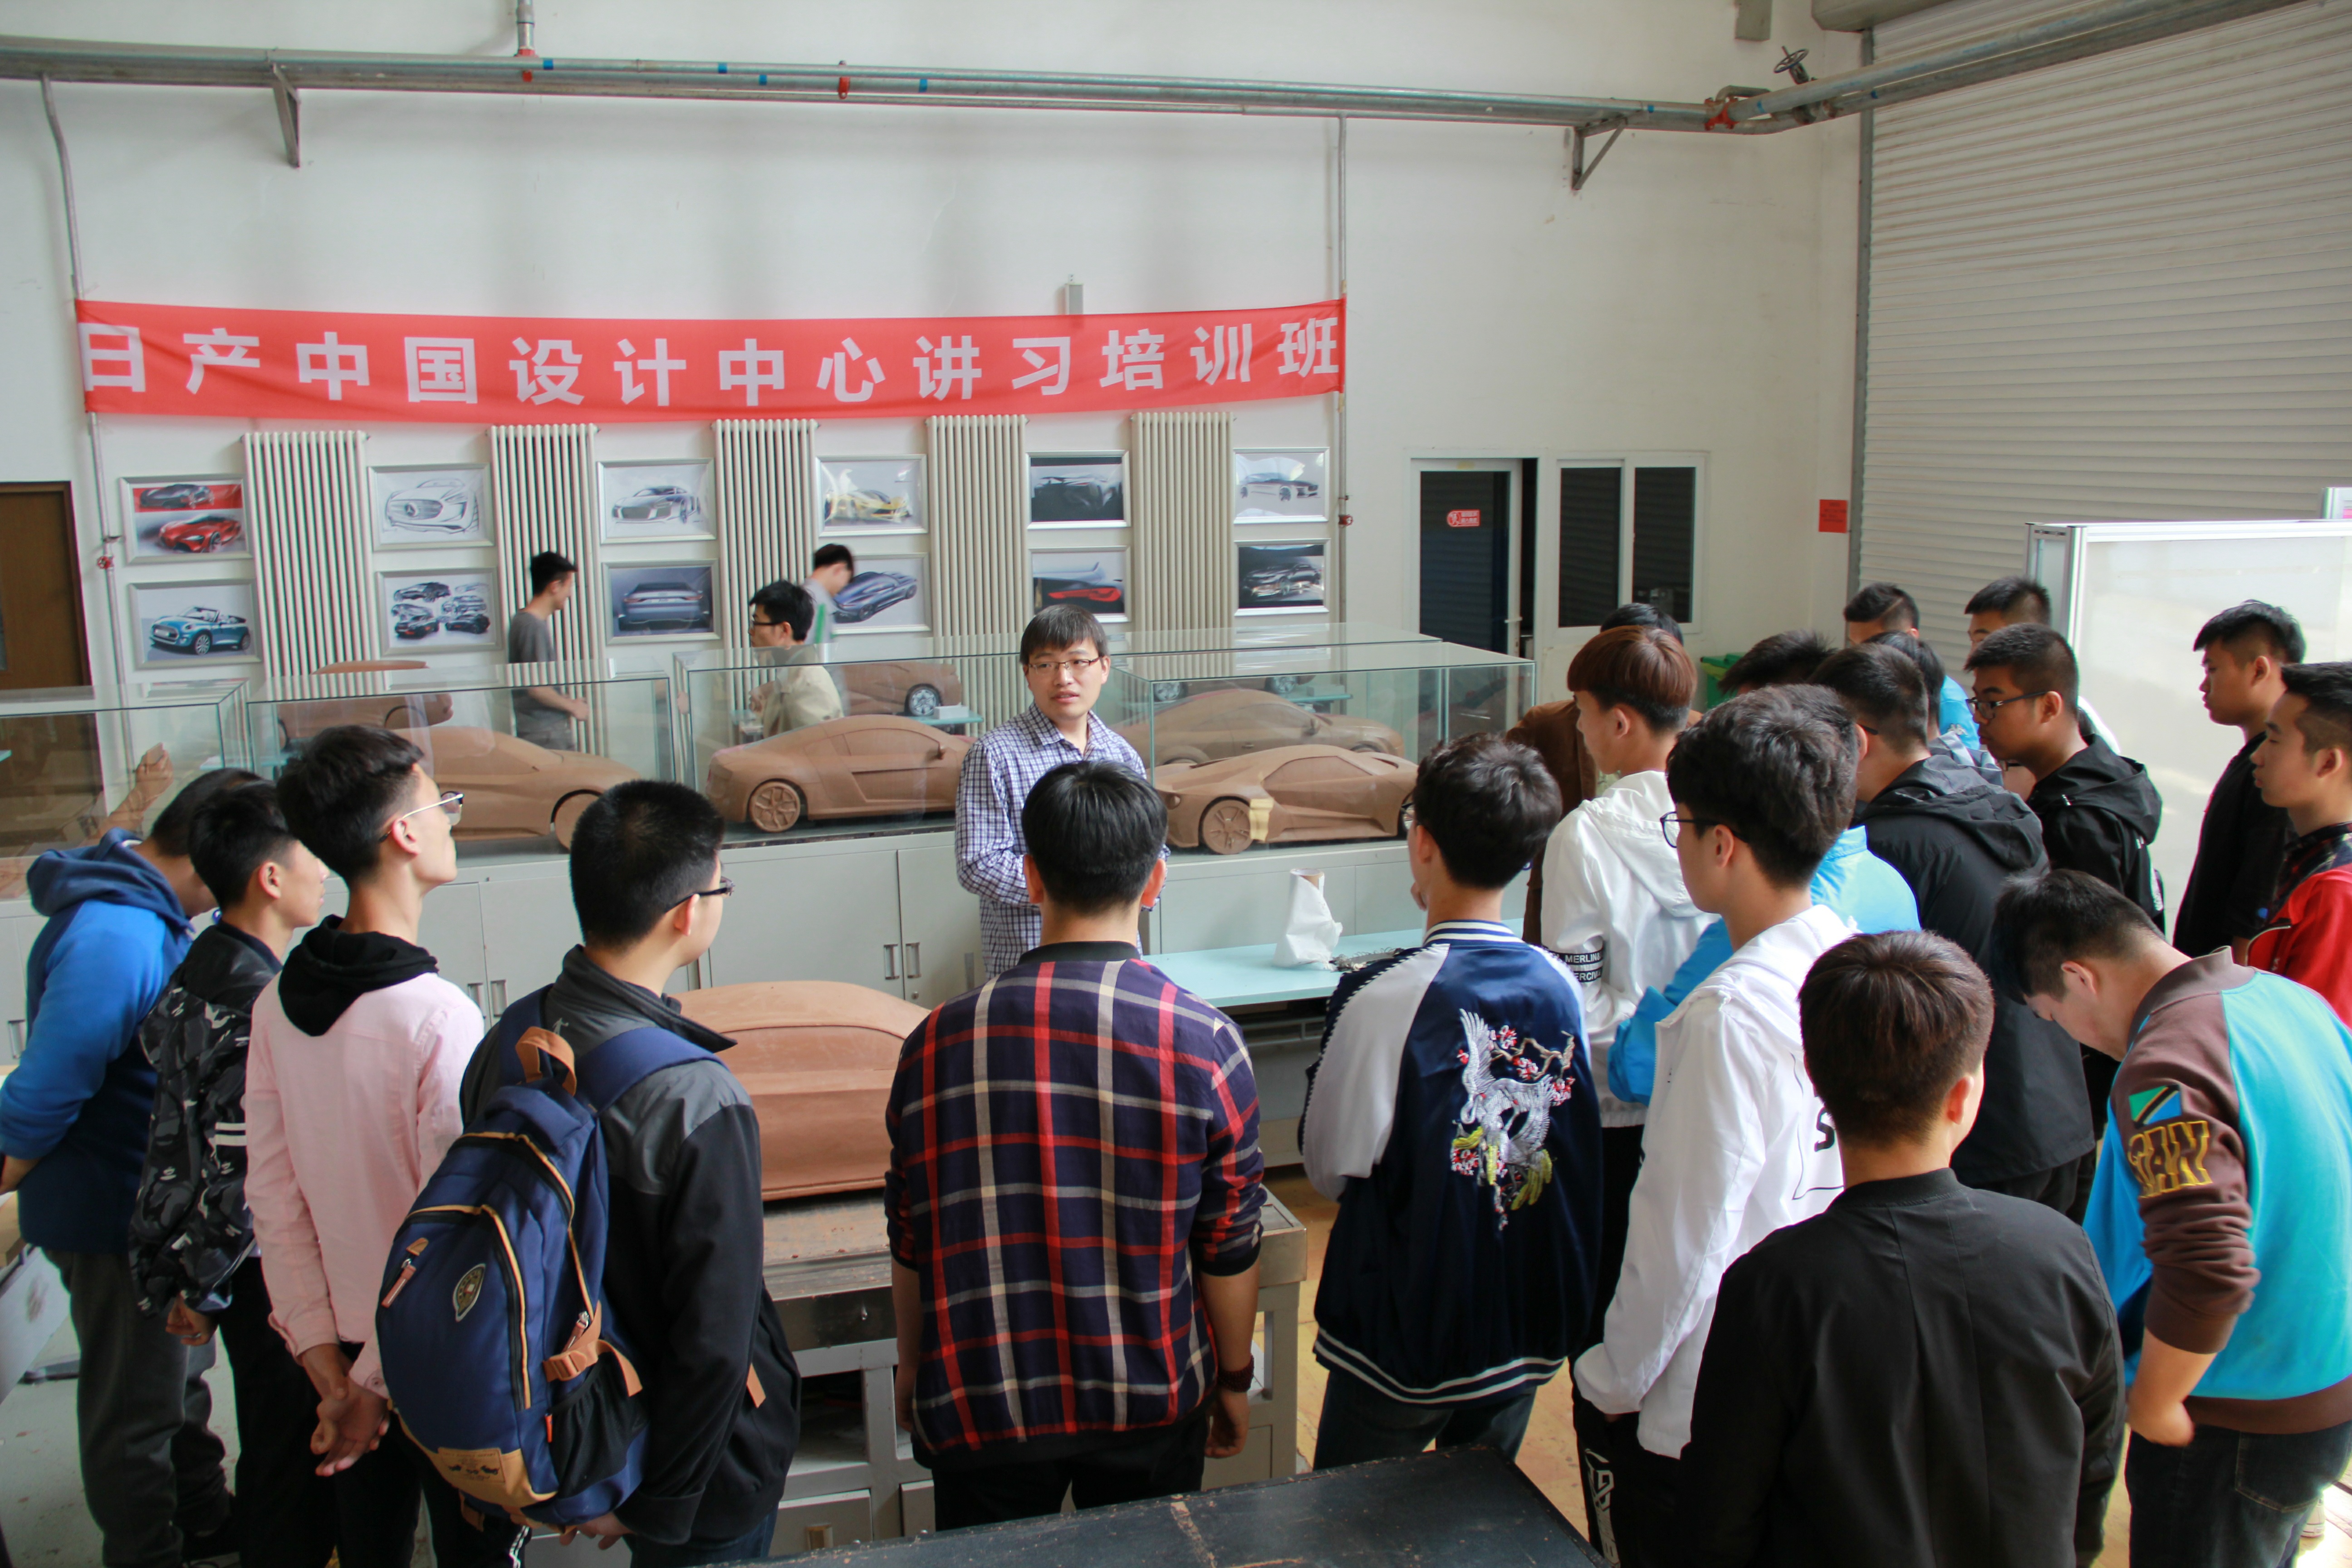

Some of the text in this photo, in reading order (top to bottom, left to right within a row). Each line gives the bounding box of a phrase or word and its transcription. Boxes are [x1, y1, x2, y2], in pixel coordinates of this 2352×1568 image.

[78, 318, 1338, 407] 日产中国设计中心讲习培训班
